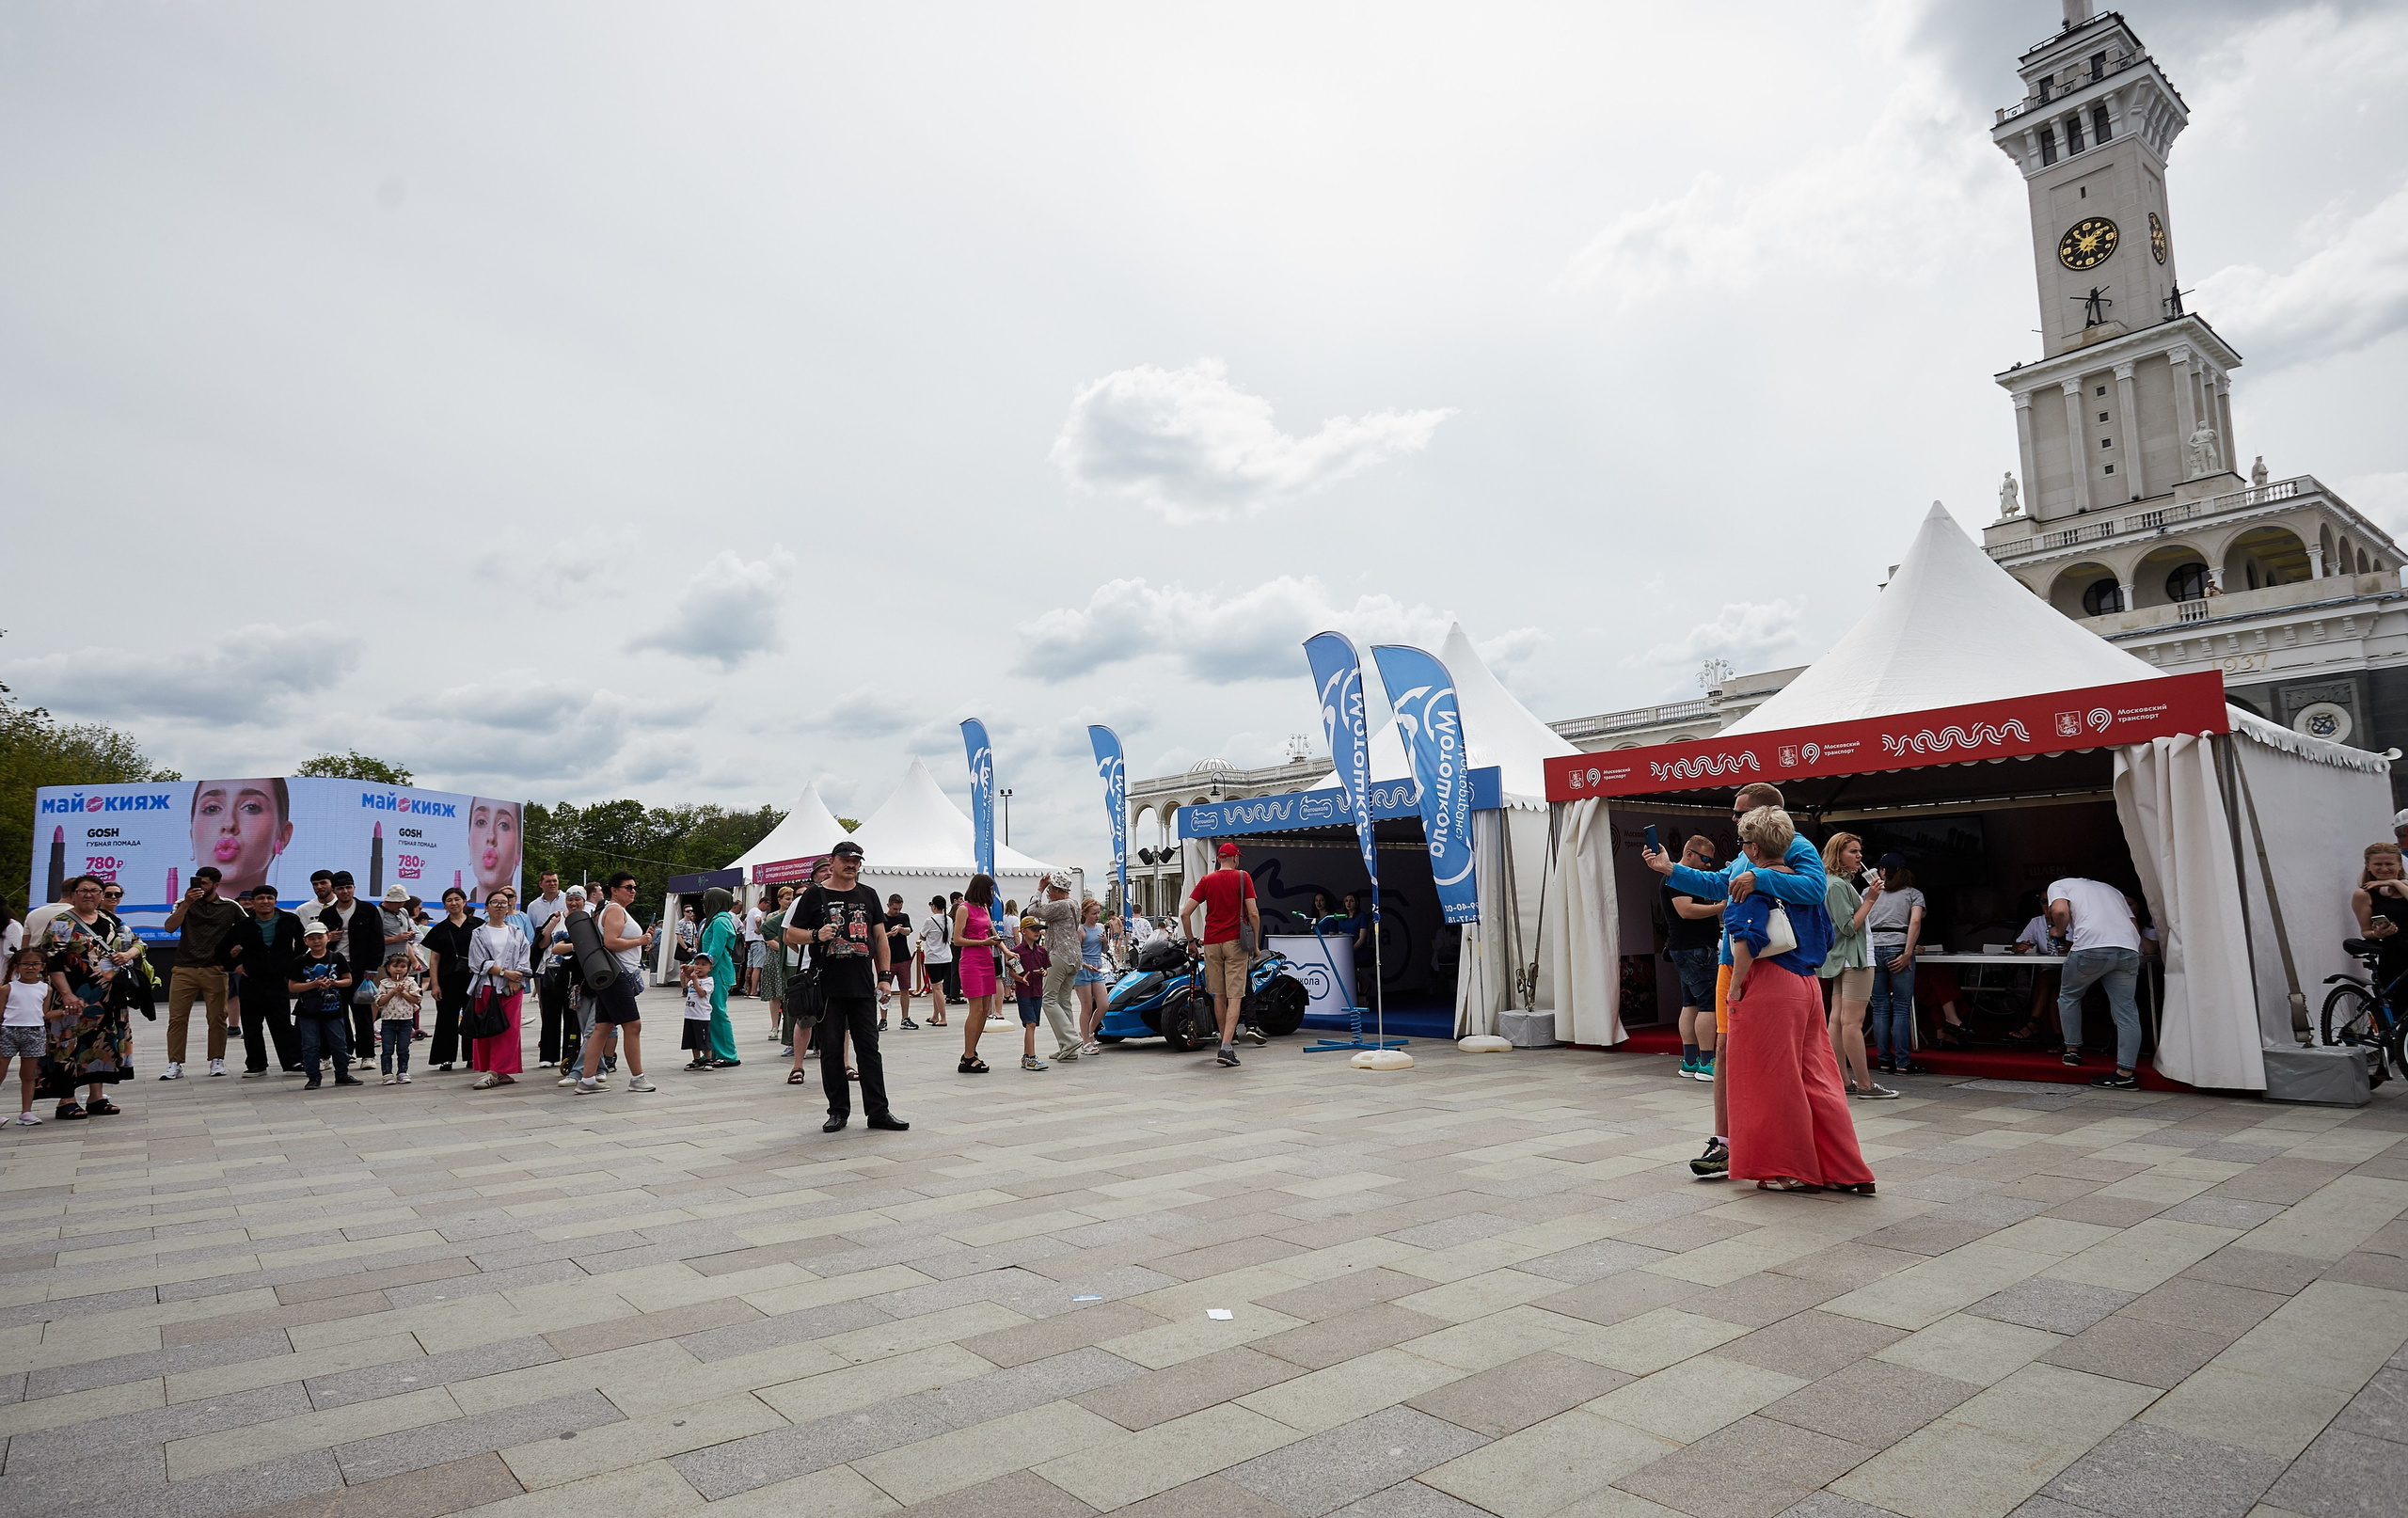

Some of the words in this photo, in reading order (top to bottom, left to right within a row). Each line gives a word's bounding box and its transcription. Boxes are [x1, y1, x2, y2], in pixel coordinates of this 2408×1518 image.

[2210, 653, 2268, 672] 1937
[2117, 704, 2167, 715] Московский
[2117, 713, 2160, 723] транспорт
[1823, 740, 1861, 750] Московский
[1824, 749, 1854, 757] транспорт
[1603, 767, 1631, 775] Московский
[87, 828, 119, 838] GOSH
[399, 828, 422, 838] GOSH
